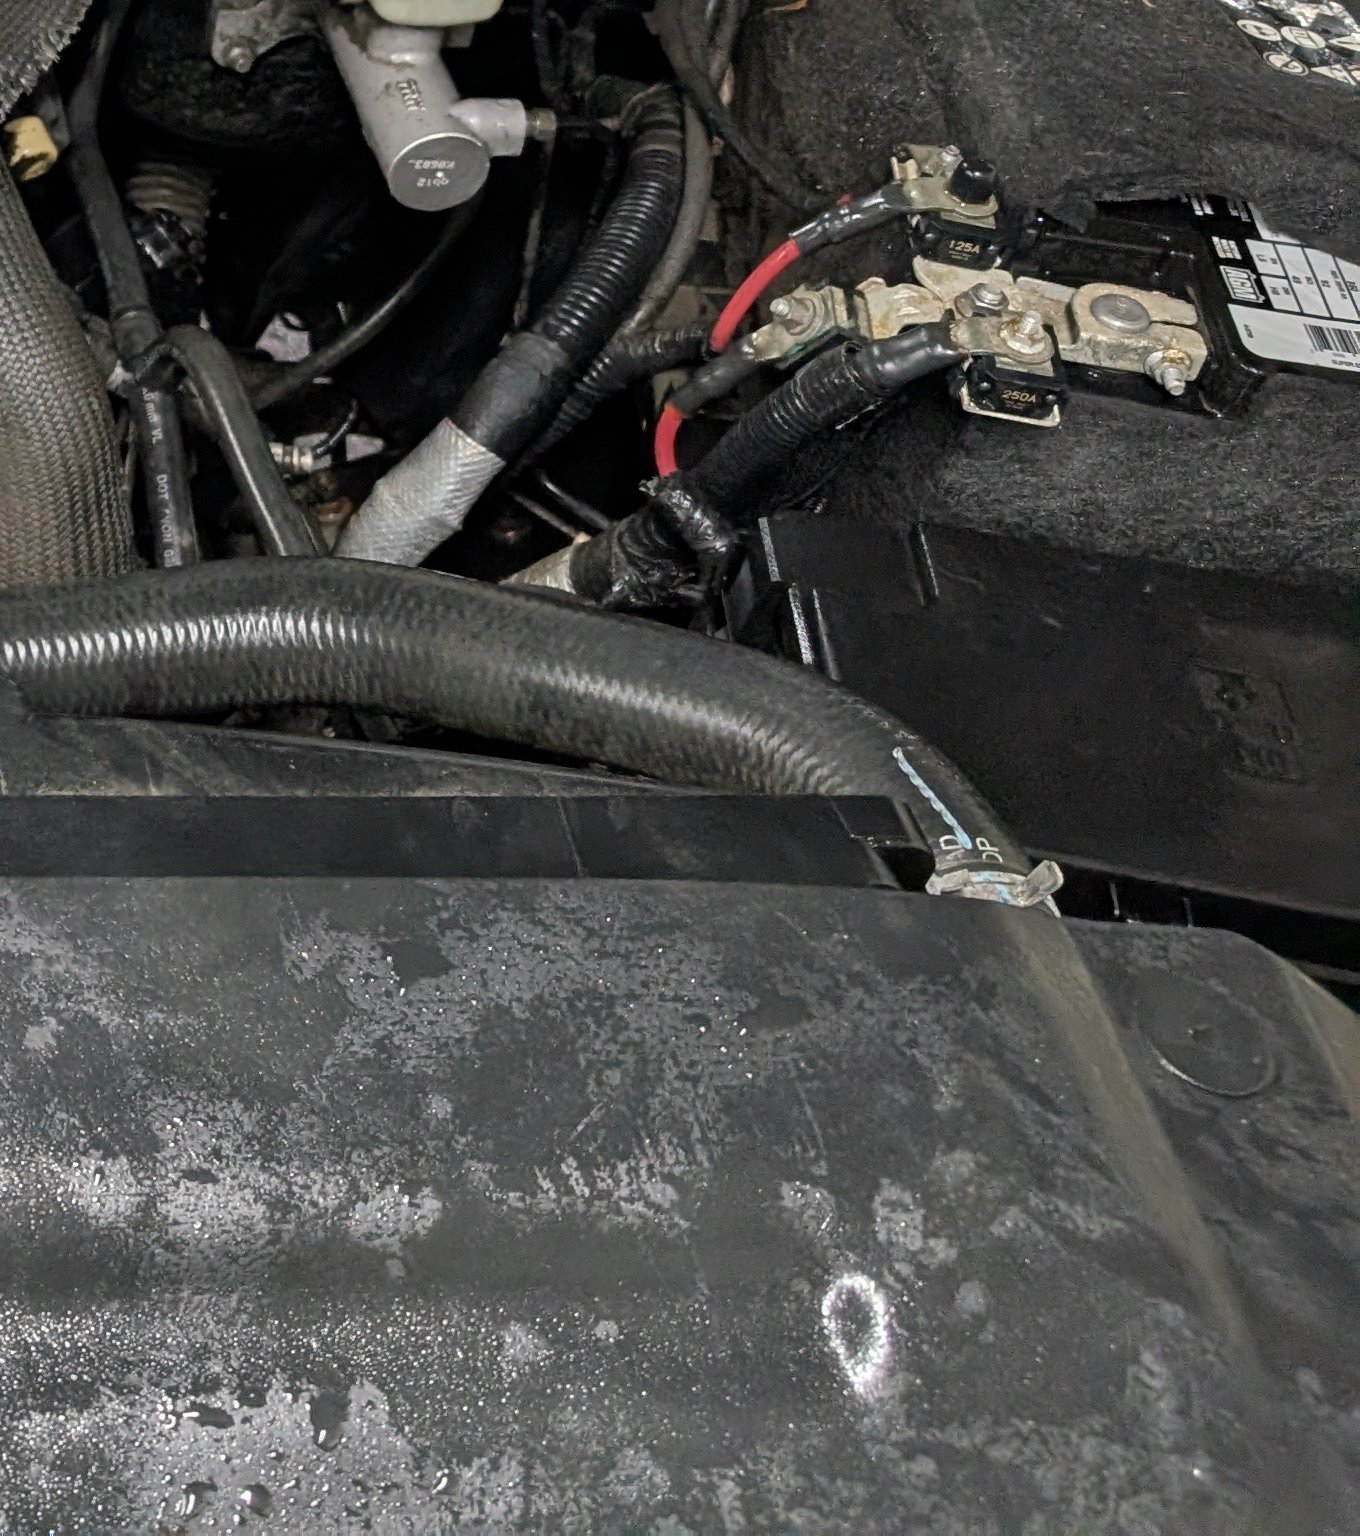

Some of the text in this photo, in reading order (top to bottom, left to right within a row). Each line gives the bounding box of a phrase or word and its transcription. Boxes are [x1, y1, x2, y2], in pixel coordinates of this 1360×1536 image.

[948, 239, 980, 255] 125A
[1225, 269, 1257, 302] AGM
[1001, 389, 1036, 403] 250A
[156, 474, 170, 500] DOT
[975, 837, 1004, 864] OP
